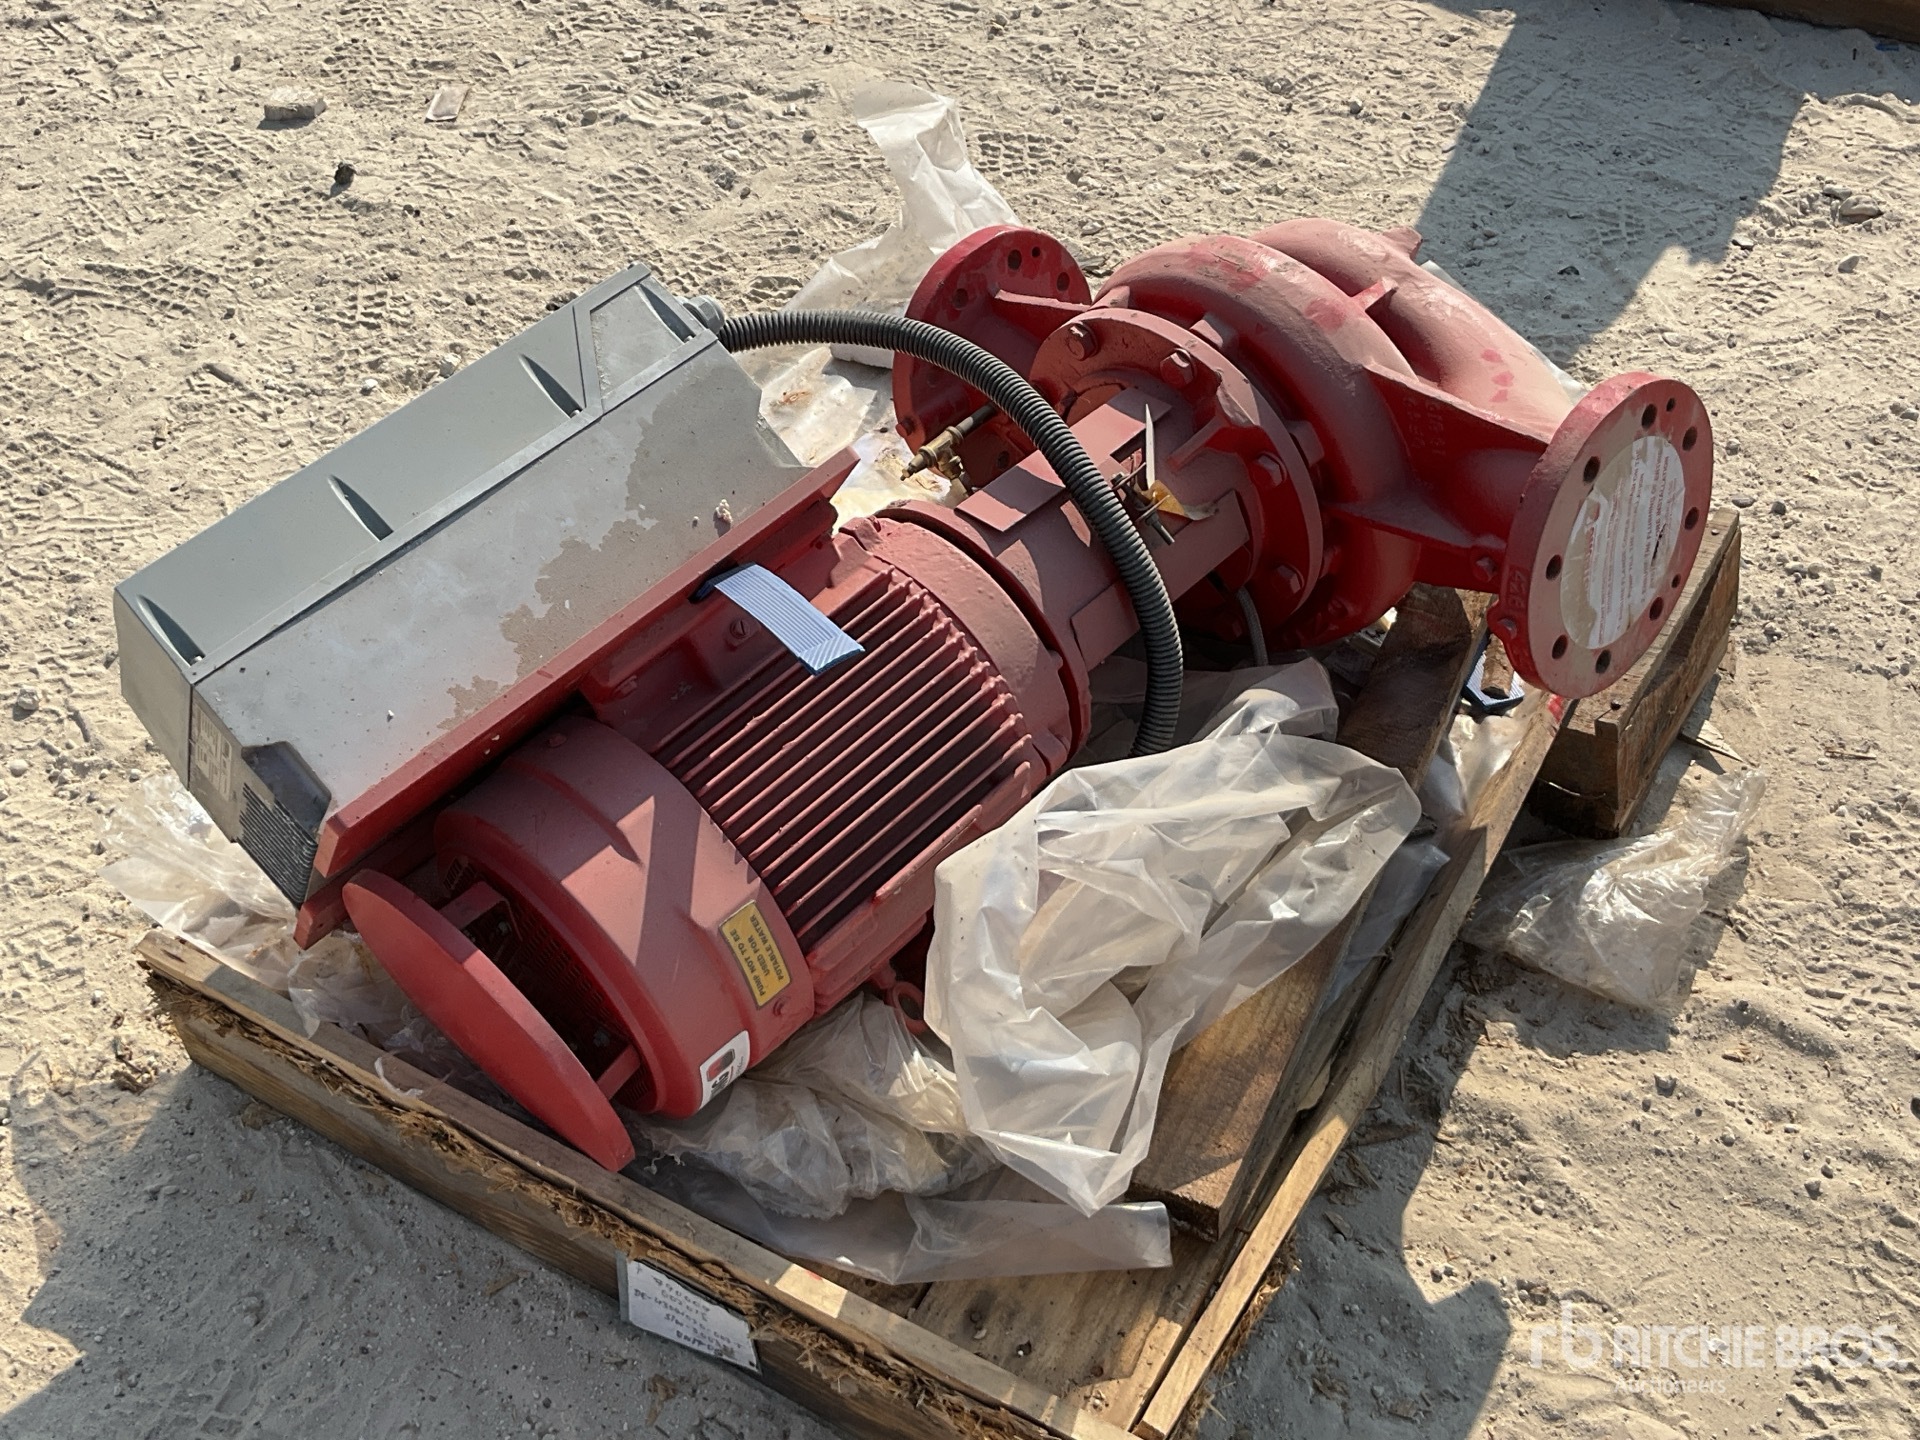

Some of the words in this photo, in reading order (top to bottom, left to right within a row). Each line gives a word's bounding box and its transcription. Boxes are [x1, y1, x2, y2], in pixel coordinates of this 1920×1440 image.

[730, 928, 740, 942] BE
[750, 914, 768, 944] WATER
[738, 943, 748, 955] TO
[748, 935, 760, 954] FOR
[745, 956, 756, 973] NOT
[757, 955, 770, 976] USED
[766, 945, 784, 980] POTABLE
[753, 975, 766, 996] PUMP
